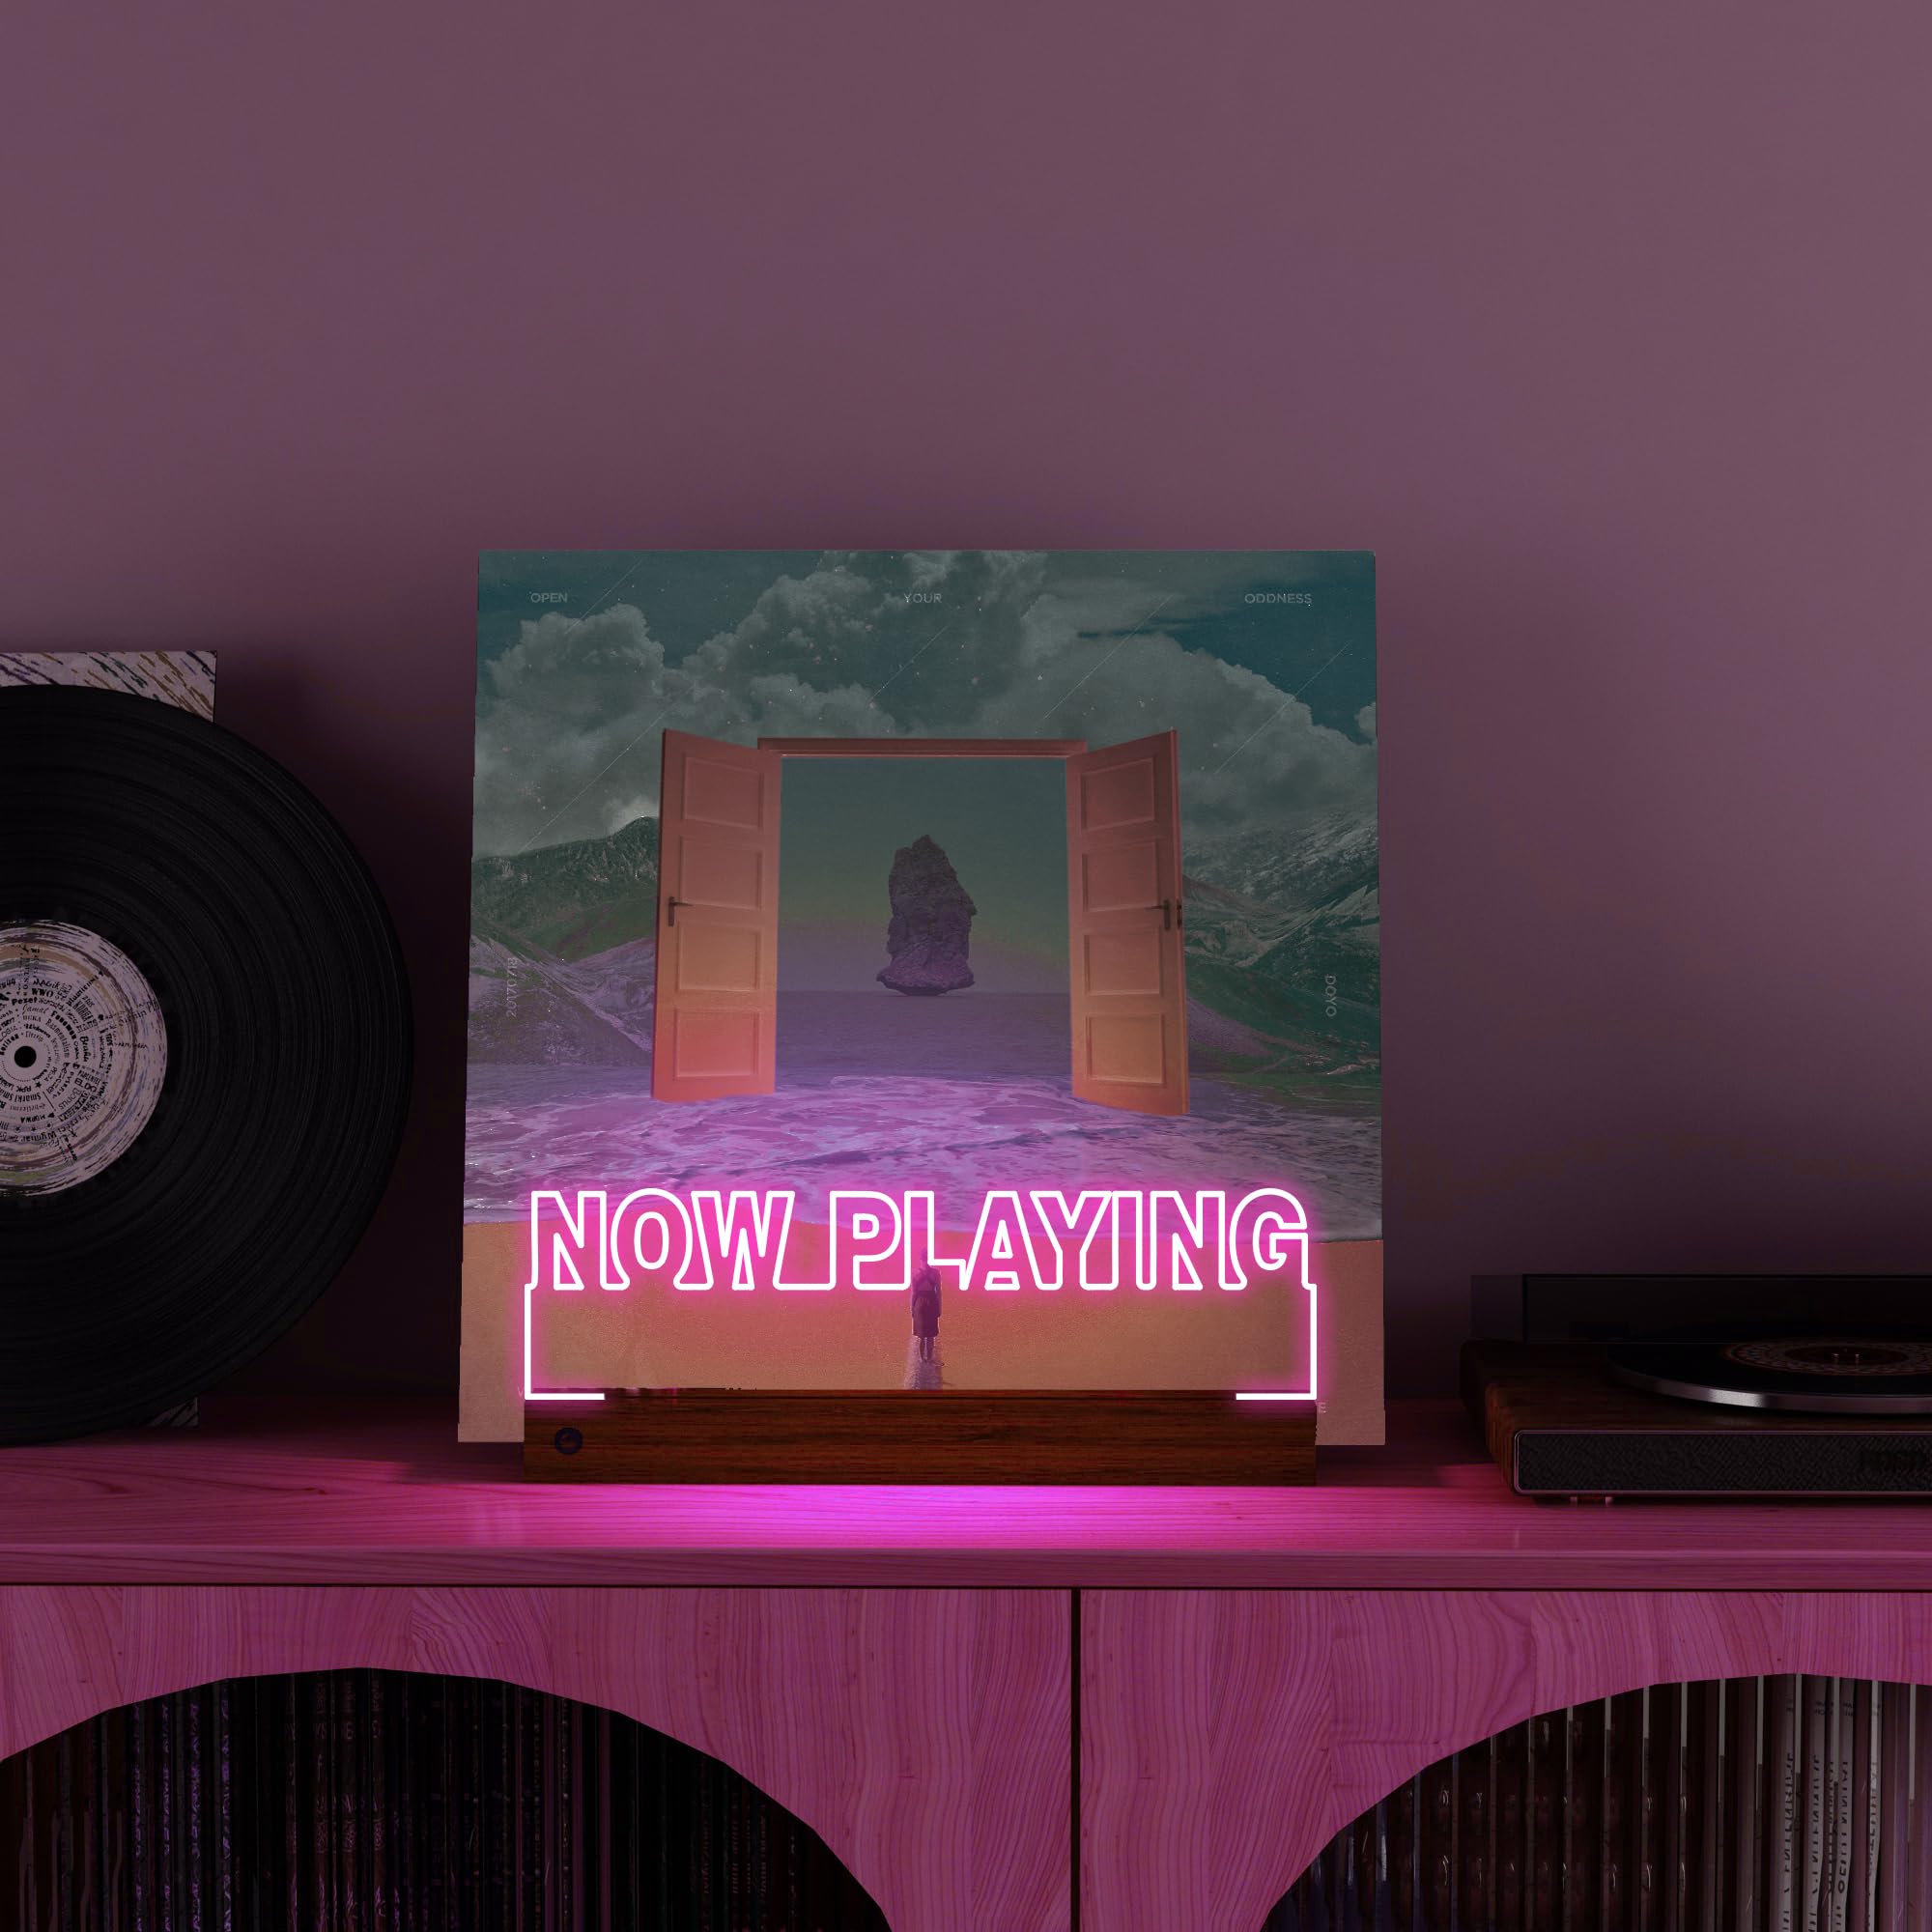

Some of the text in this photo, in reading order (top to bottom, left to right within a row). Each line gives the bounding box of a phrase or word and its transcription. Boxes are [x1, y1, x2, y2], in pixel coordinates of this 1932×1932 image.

[529, 592, 1313, 604] OPEN YOUR ODDNESS
[1324, 975, 1337, 1017] DOYO
[530, 1187, 1309, 1291] NOW PLAYING
